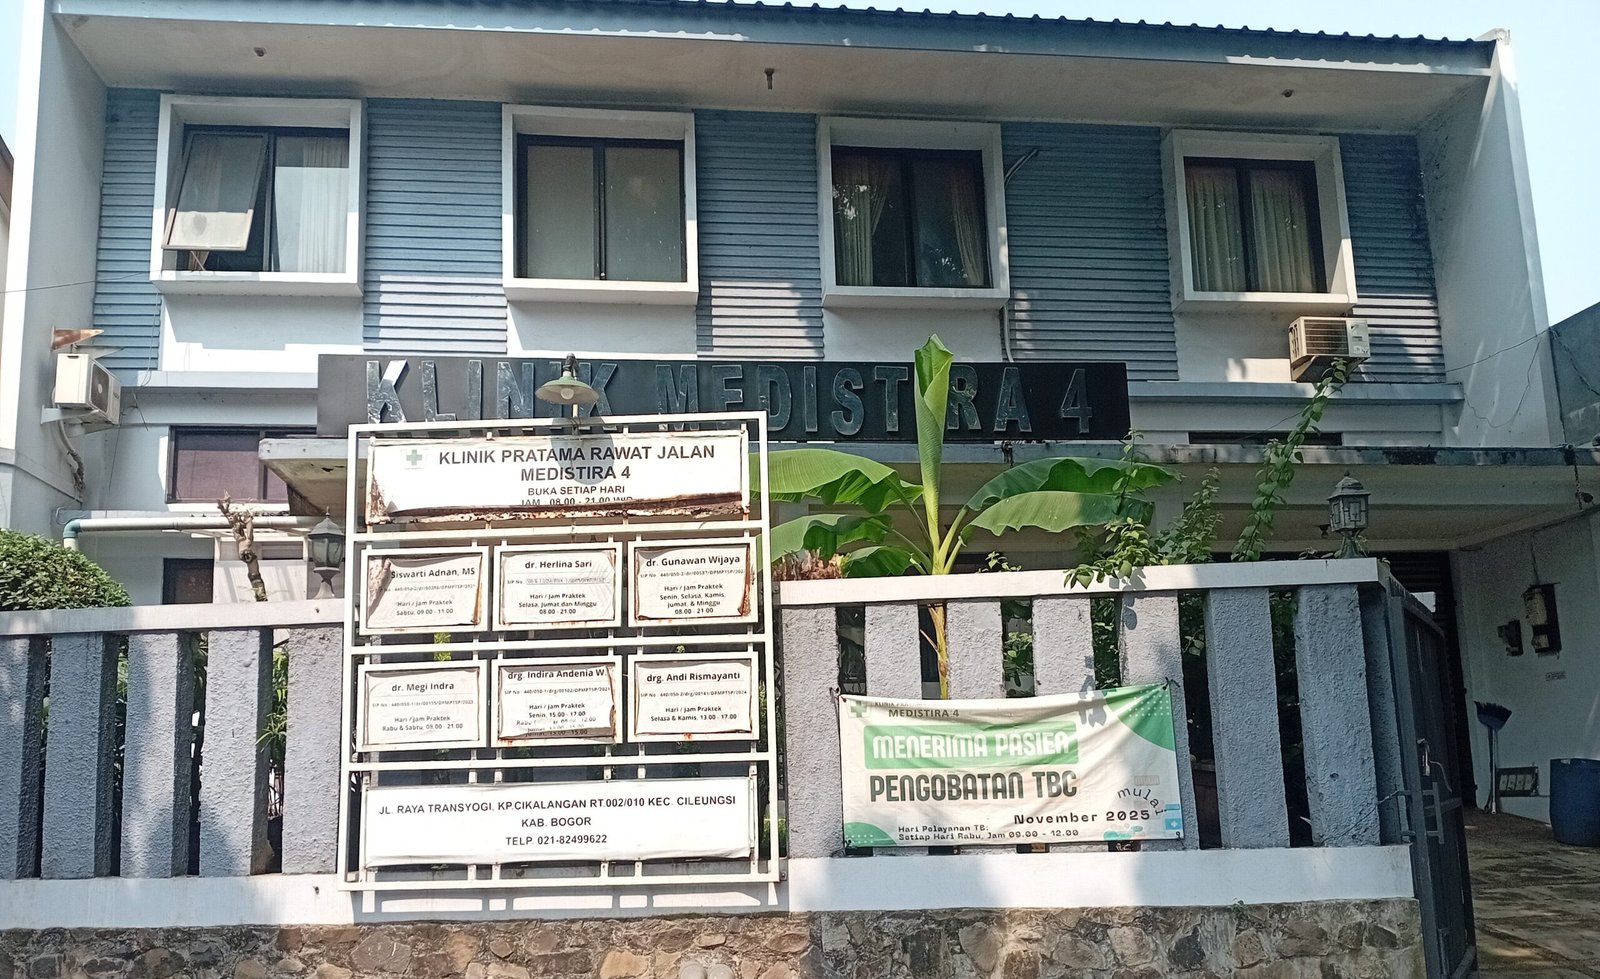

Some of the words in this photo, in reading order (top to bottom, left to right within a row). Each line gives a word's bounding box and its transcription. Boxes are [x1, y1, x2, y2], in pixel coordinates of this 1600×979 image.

[366, 359, 618, 430] KLINIK
[655, 364, 1032, 436] MEDISTRA
[1059, 368, 1093, 434] 4
[439, 450, 496, 465] KLINIK
[501, 448, 586, 463] PRATAMA
[590, 446, 652, 461] RAWAT
[657, 445, 715, 459] JALAN
[521, 466, 616, 482] MEDISTIRA
[621, 466, 631, 479] 4
[560, 486, 597, 494] SETIAP
[661, 558, 706, 566] Gunawan
[708, 556, 740, 565] Wijaya
[391, 569, 426, 578] Siswarti
[508, 672, 525, 681] drg.
[556, 669, 594, 677] Andenia
[647, 675, 664, 683] drg.
[690, 672, 740, 681] Rismayanti
[407, 683, 428, 692] Megi
[889, 709, 950, 718] MEDISTIRA
[872, 732, 988, 759] MENERIMA
[995, 730, 1070, 758] PASIEN
[870, 772, 1023, 802] PENGOBATAN
[1031, 771, 1078, 798] TBC
[379, 804, 394, 815] JL.
[397, 804, 425, 814] RAYA
[427, 802, 494, 813] TRANSYOGI,
[590, 797, 645, 808] RT.002/010
[648, 796, 673, 807] KEC.
[676, 795, 736, 806] CILEUNGSI
[1116, 785, 1167, 816] mulai
[521, 818, 547, 828] KAB.
[550, 816, 592, 827] BOGOR
[1014, 812, 1098, 825] November
[1106, 809, 1150, 821] 2025
[899, 832, 930, 842] Setiap
[934, 832, 954, 840] Hari
[958, 832, 984, 840] Rabu,
[1008, 830, 1038, 838] 09.00
[1050, 829, 1078, 837] 12.00
[922, 825, 971, 834] Pelayanan
[505, 836, 534, 846] TELP.
[537, 834, 607, 845] 021-82499622
